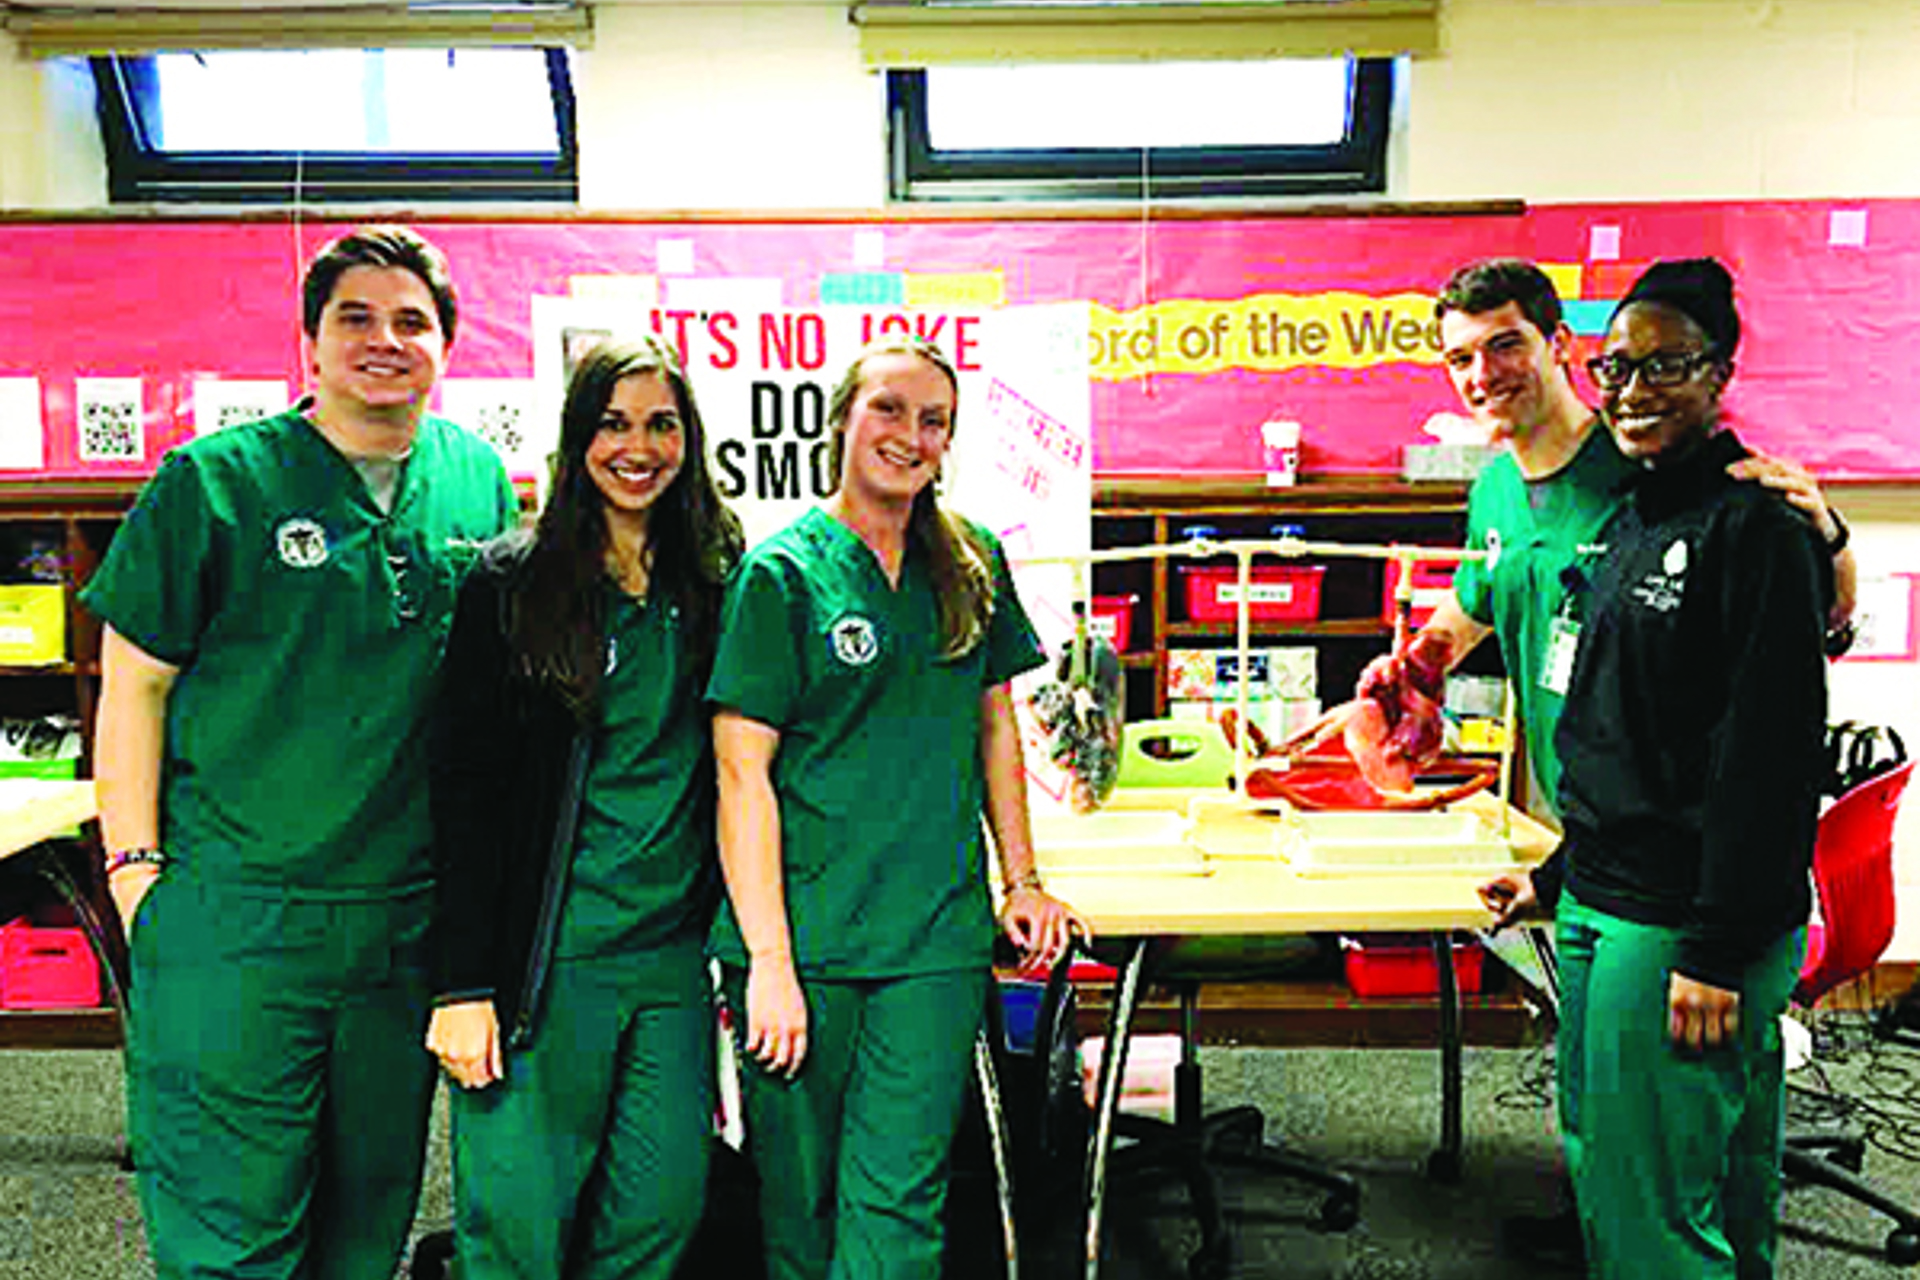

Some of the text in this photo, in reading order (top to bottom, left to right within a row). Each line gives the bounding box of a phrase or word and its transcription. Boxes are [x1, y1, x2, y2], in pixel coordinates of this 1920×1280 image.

[760, 313, 826, 370] NO
[1179, 313, 1229, 360] of
[1248, 312, 1329, 356] the
